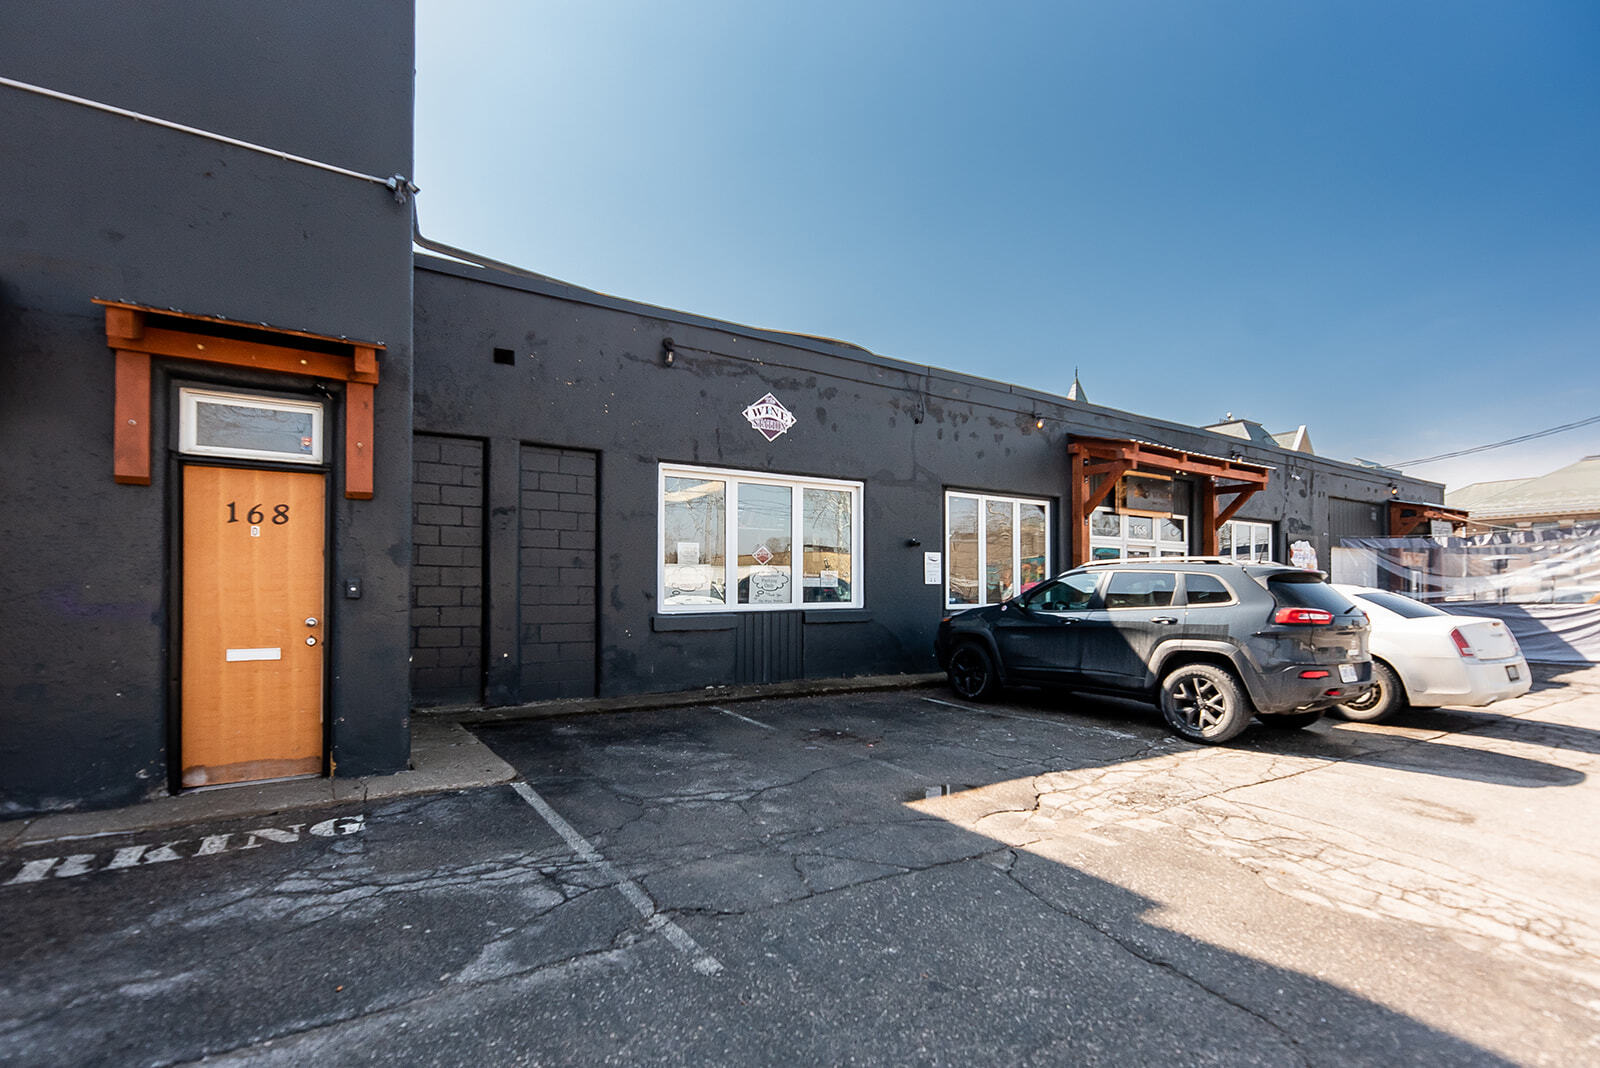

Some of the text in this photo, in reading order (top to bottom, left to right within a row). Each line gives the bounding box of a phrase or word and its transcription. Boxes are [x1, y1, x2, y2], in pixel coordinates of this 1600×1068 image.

[751, 406, 788, 422] WINE
[226, 501, 289, 525] 168
[2, 814, 367, 886] RKING
